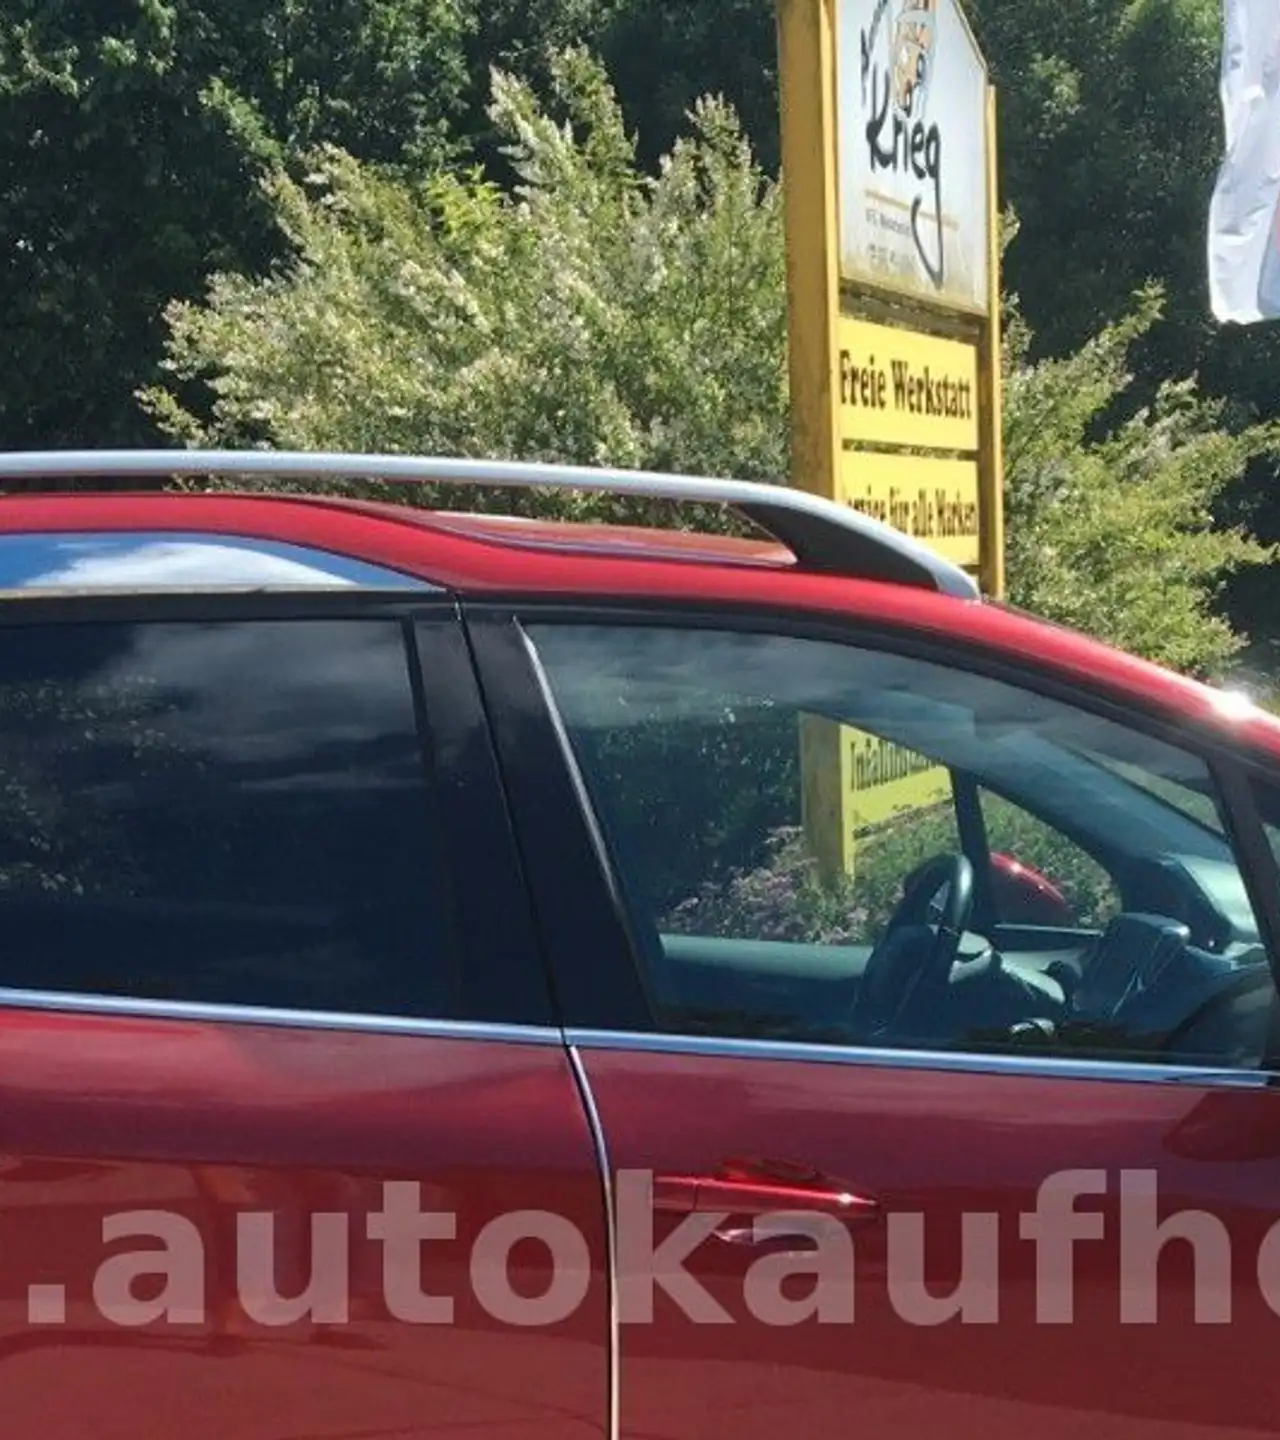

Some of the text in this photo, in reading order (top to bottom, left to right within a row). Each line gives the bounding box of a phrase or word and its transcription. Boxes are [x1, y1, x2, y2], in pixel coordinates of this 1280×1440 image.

[866, 61, 944, 290] Krieg
[839, 349, 972, 419] Freie Werkstatt
